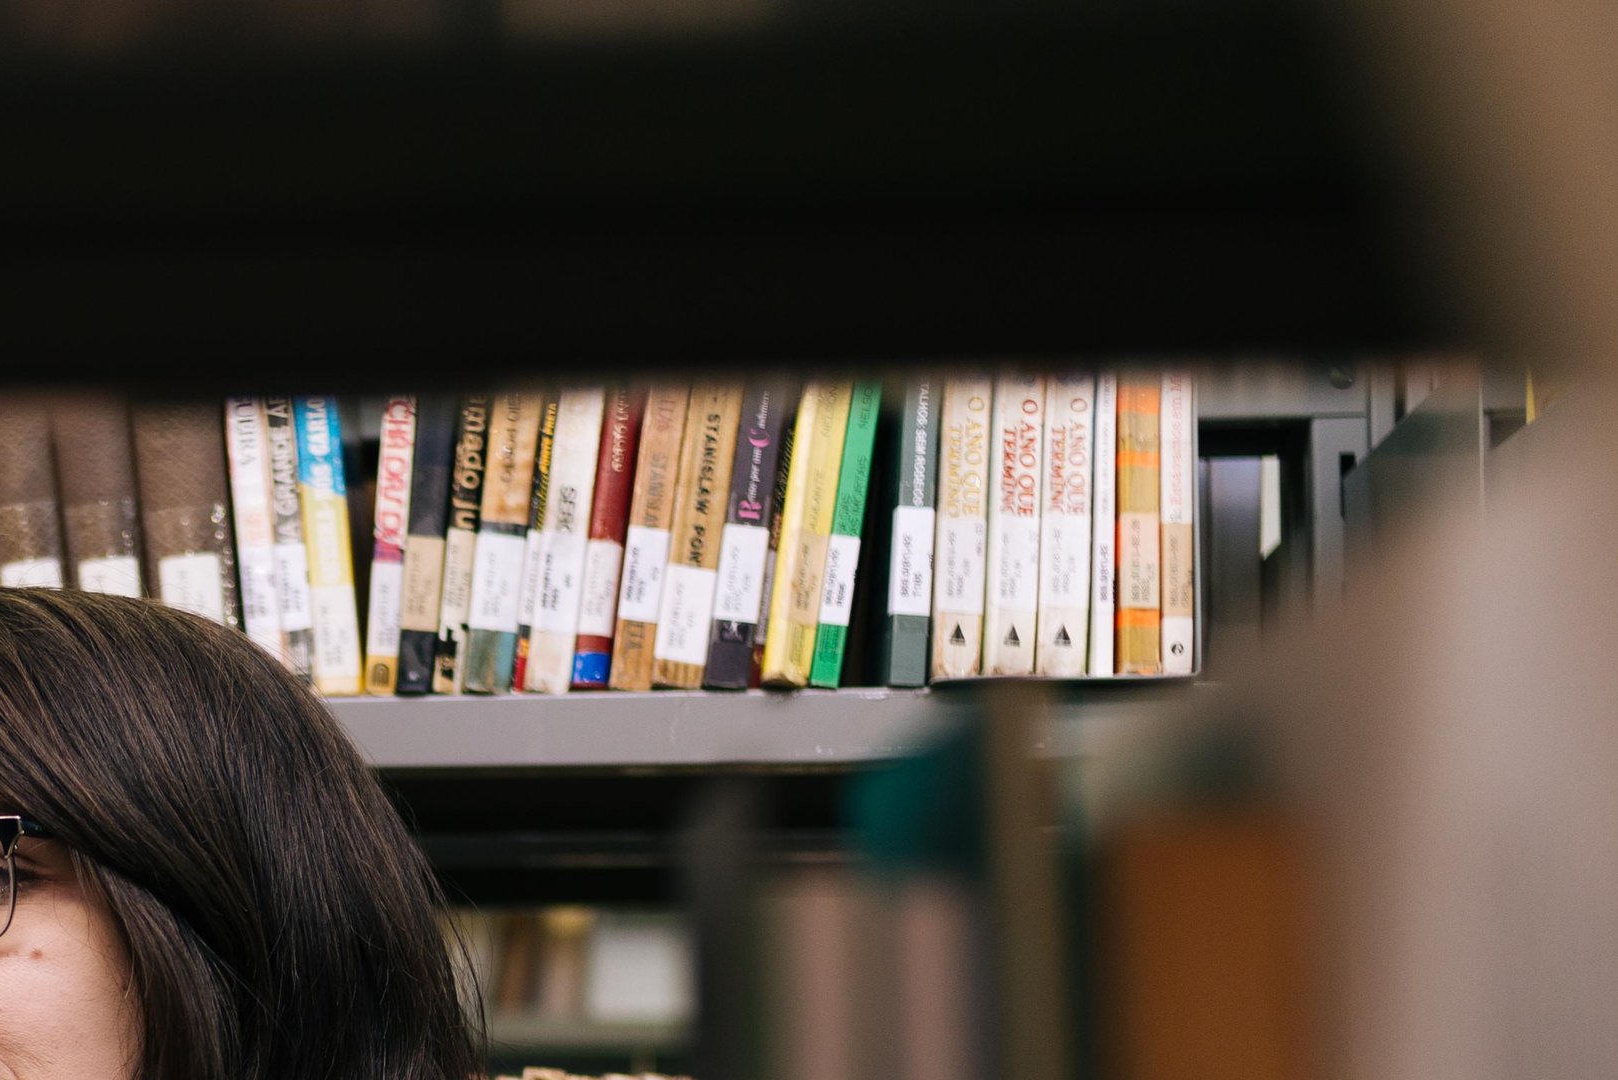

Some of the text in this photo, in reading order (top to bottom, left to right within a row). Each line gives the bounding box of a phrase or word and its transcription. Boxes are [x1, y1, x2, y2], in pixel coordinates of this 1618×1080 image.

[858, 383, 874, 431] NELSO
[968, 397, 984, 412] O
[696, 412, 722, 515] STANISLAW
[965, 417, 983, 466] ANO
[1016, 399, 1038, 518] O ANO QUE
[1066, 398, 1088, 516] O ANO QUE
[962, 470, 981, 516] QUE
